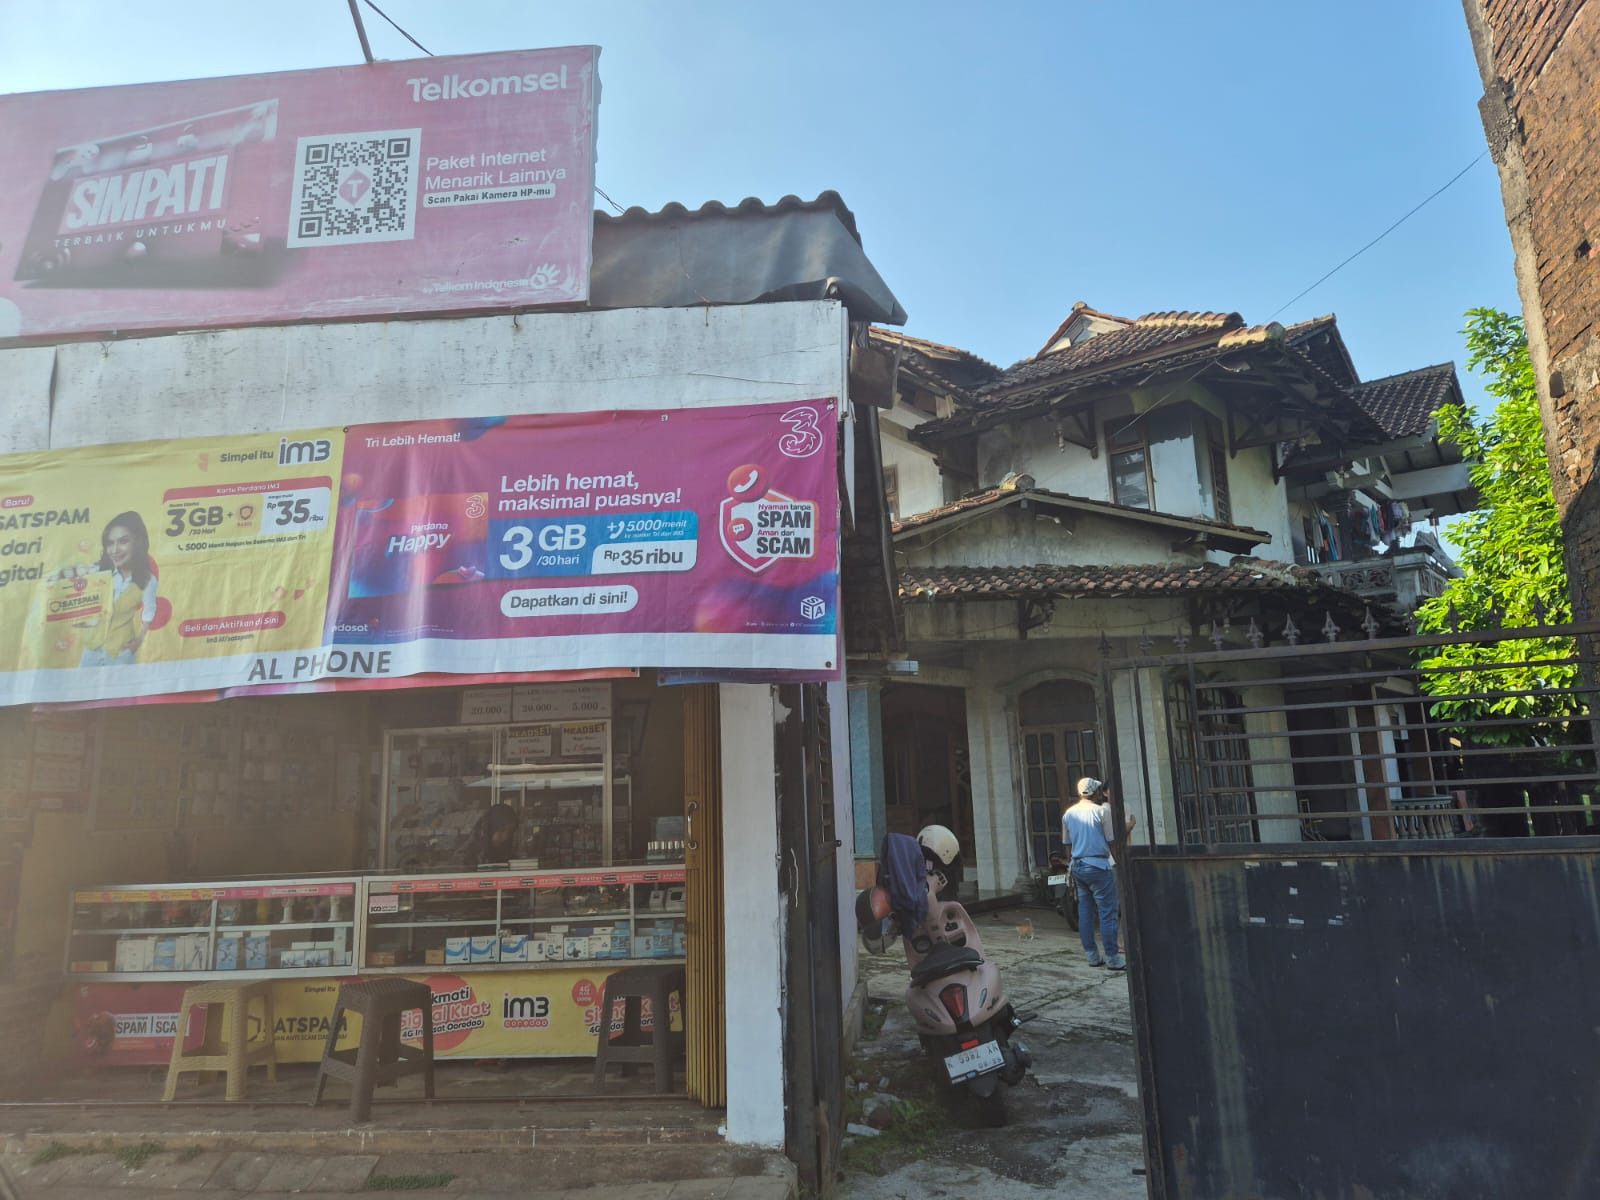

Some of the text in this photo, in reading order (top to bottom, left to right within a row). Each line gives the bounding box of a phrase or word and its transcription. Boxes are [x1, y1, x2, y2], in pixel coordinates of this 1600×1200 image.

[406, 64, 567, 103] Telkomsel
[426, 149, 547, 172] Paket Internet
[425, 167, 566, 191] Menarik Lainnya
[66, 153, 229, 230] SIMPATI
[428, 186, 551, 205] Scan Pakai Kamera HP-mu
[53, 218, 228, 249] TERBAIK UNTUKMU
[432, 280, 472, 293] Telkom
[365, 432, 461, 448] Tri Lebih Hemat!
[778, 406, 823, 458] 3
[220, 438, 331, 465] Simpel itu im3
[500, 470, 640, 493] Lebih hemat,
[498, 487, 682, 512] maksimal puasnya!
[758, 503, 811, 512] Nyaman tanpa
[165, 505, 224, 537] 3 GB
[266, 501, 277, 511] Rp
[275, 498, 311, 525] 35
[757, 510, 811, 529] SPAM
[411, 521, 448, 532] Perdana
[661, 520, 687, 529] menit
[757, 528, 795, 537] Aman dari
[1, 536, 43, 556] dari
[185, 541, 207, 551] 5000
[388, 532, 451, 554] Happy
[499, 523, 588, 571] 3 GB
[756, 537, 811, 556] SCAM
[536, 554, 580, 567] /30 hari
[603, 548, 683, 566] Rp 35 ribu
[509, 591, 628, 610] Dapatkan di sini!
[185, 623, 201, 632] Beli
[201, 623, 219, 632] dan
[219, 618, 254, 631] Aktifkan
[247, 650, 393, 682] AL PHONE
[431, 986, 472, 1005] kmati
[401, 1000, 489, 1028] Sigal Kuat
[503, 992, 550, 1019] im3
[115, 1020, 178, 1036] SPAM SCA
[447, 1018, 482, 1031] Ooredoo
[503, 1020, 549, 1029] ooredoo
